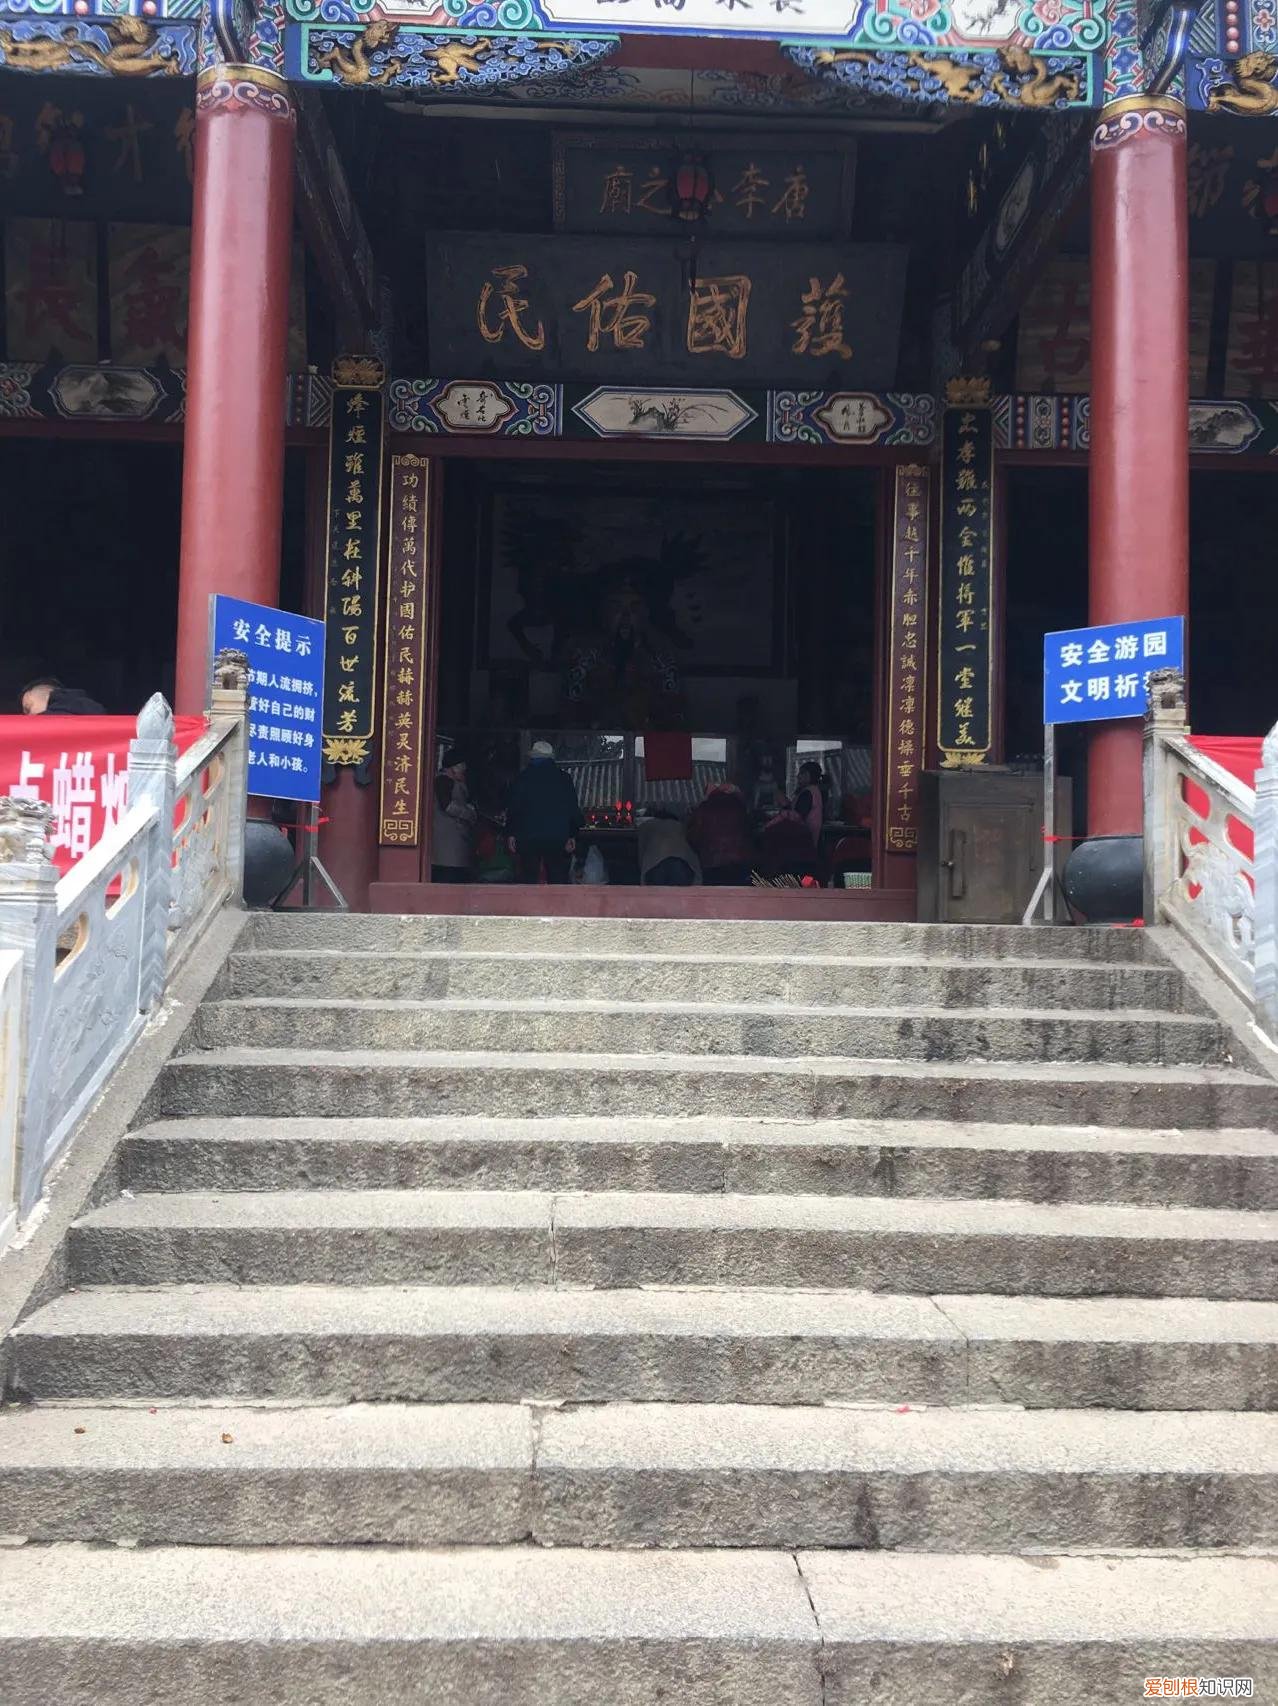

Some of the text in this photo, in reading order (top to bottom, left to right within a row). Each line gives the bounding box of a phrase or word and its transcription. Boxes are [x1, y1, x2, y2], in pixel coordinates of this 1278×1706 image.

[232, 618, 312, 657] 安全提示
[1060, 631, 1168, 668] 安全游园
[1060, 672, 1151, 704] 文明祈
